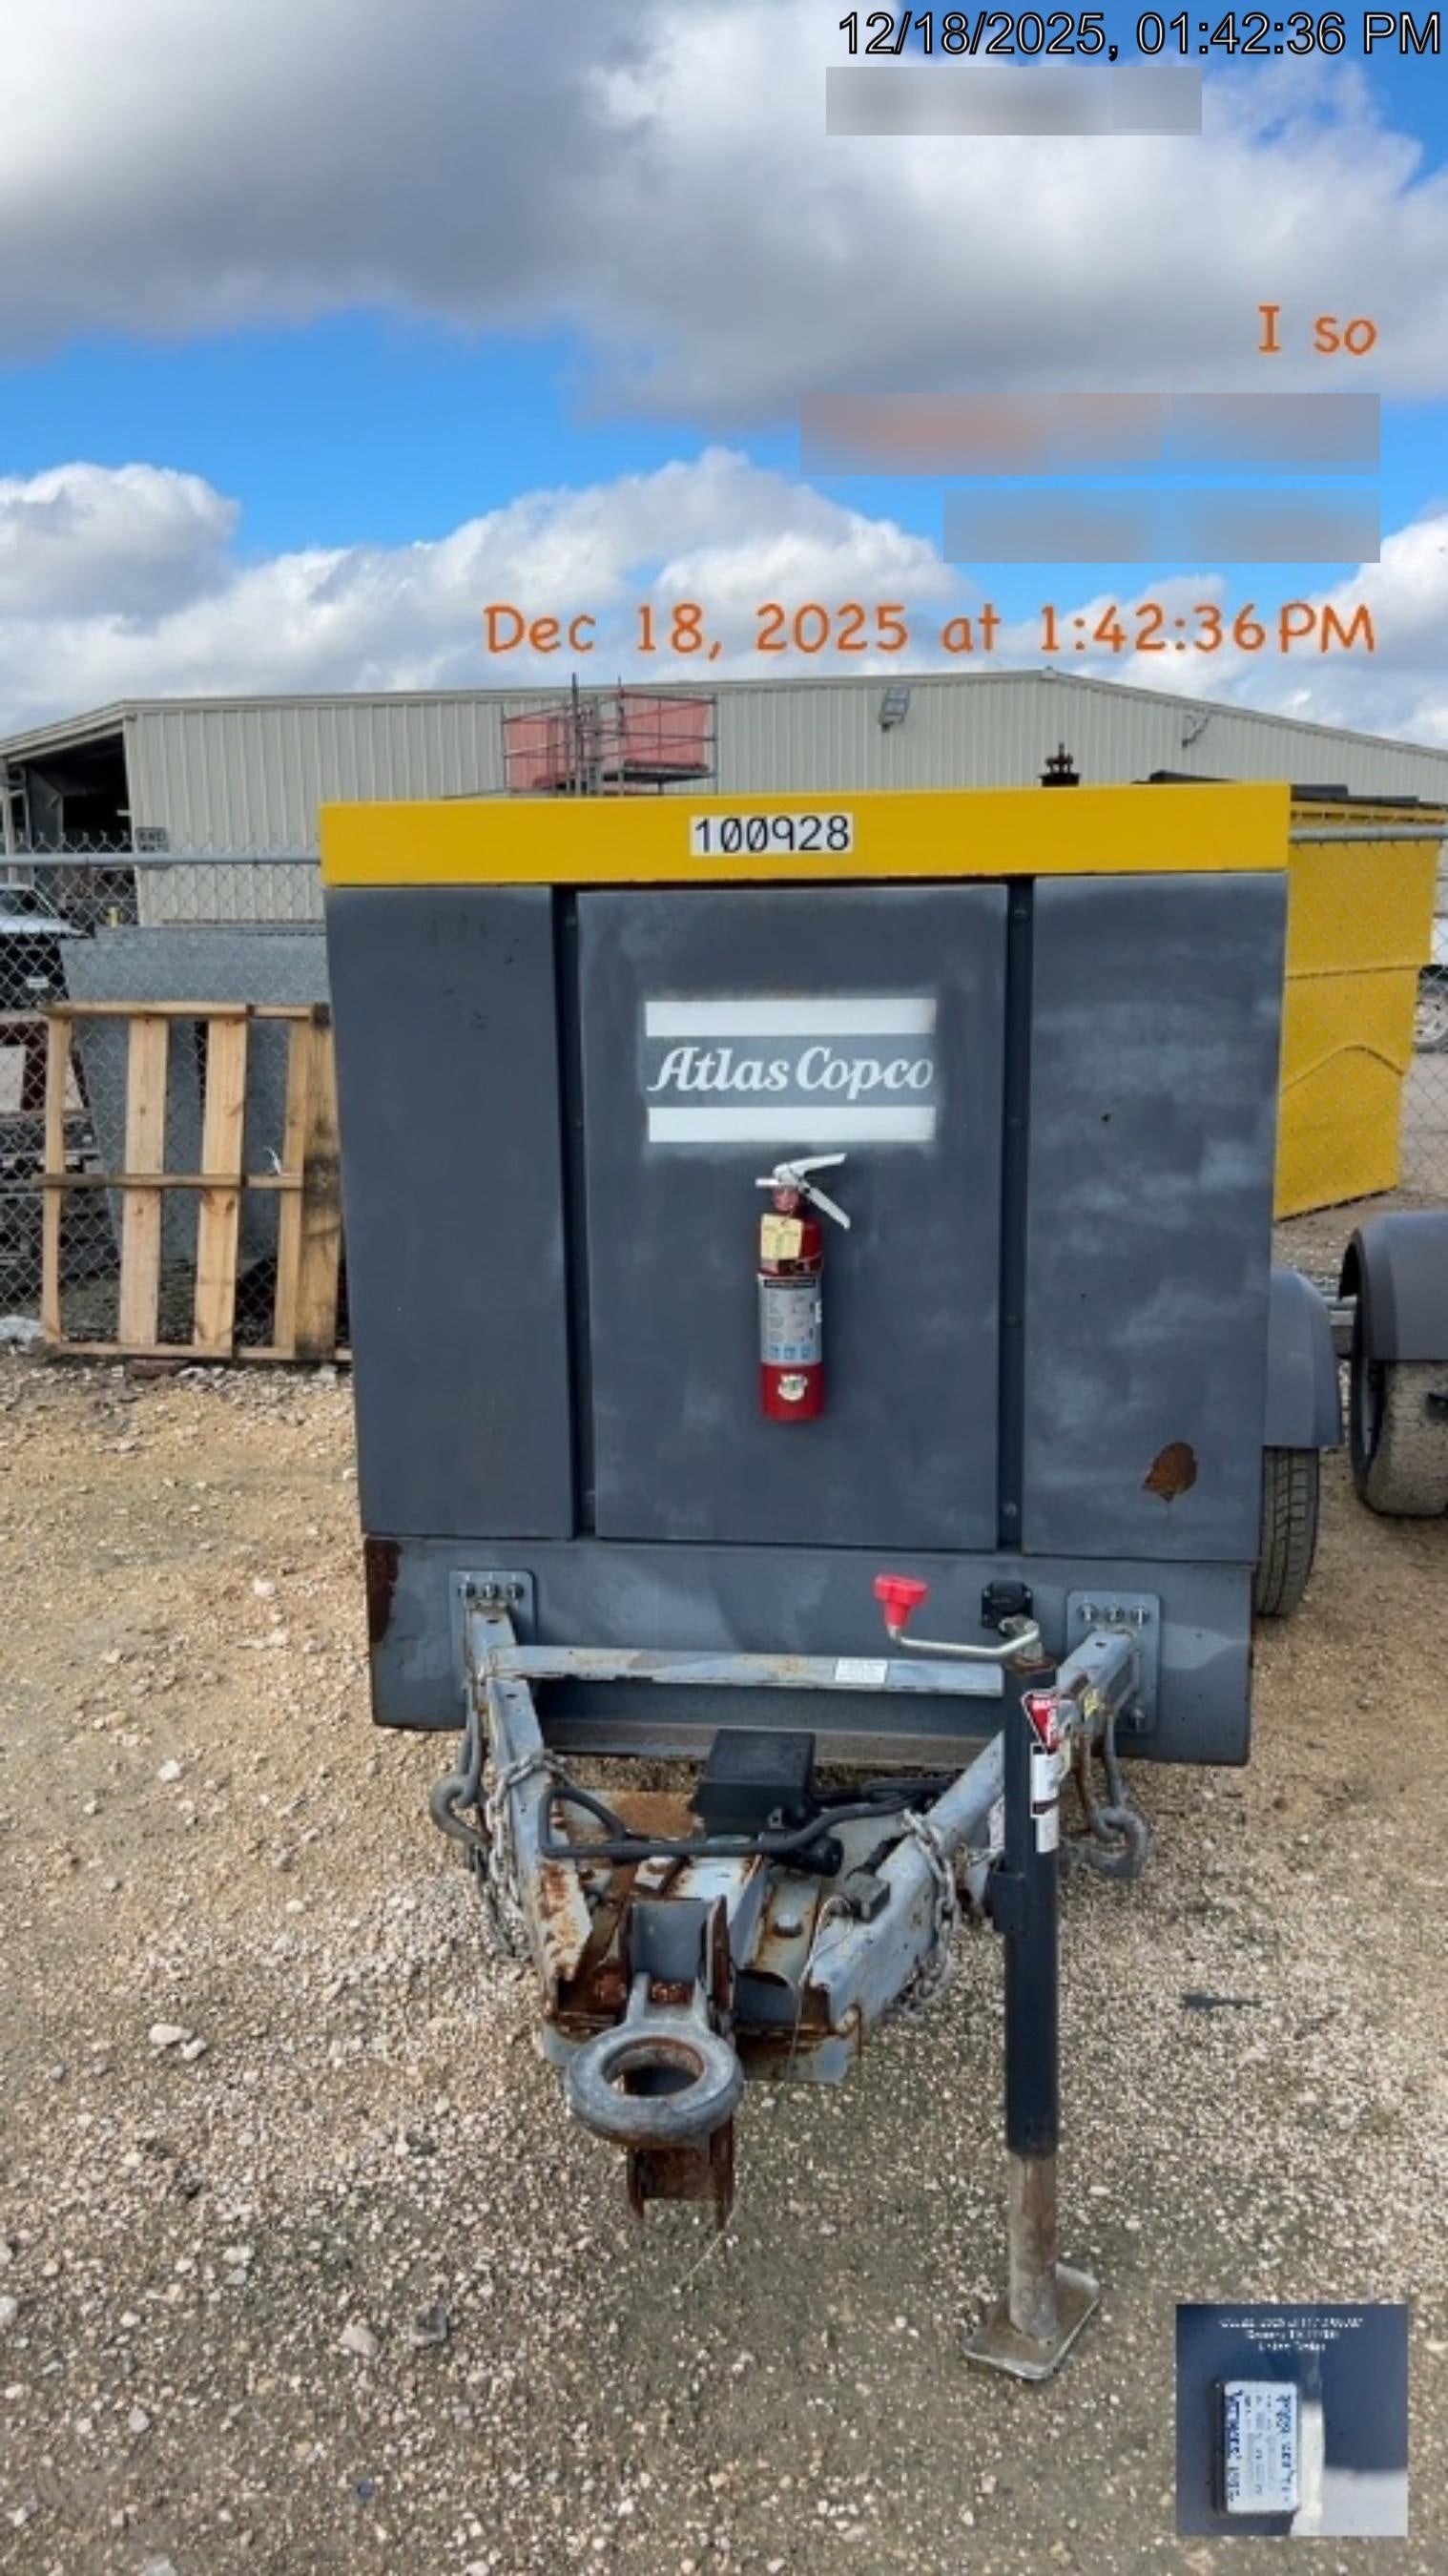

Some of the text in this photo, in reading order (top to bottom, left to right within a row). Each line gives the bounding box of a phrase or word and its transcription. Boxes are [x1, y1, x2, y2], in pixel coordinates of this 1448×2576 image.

[694, 816, 850, 853] 100928
[647, 1046, 934, 1099] Atlas Copco
